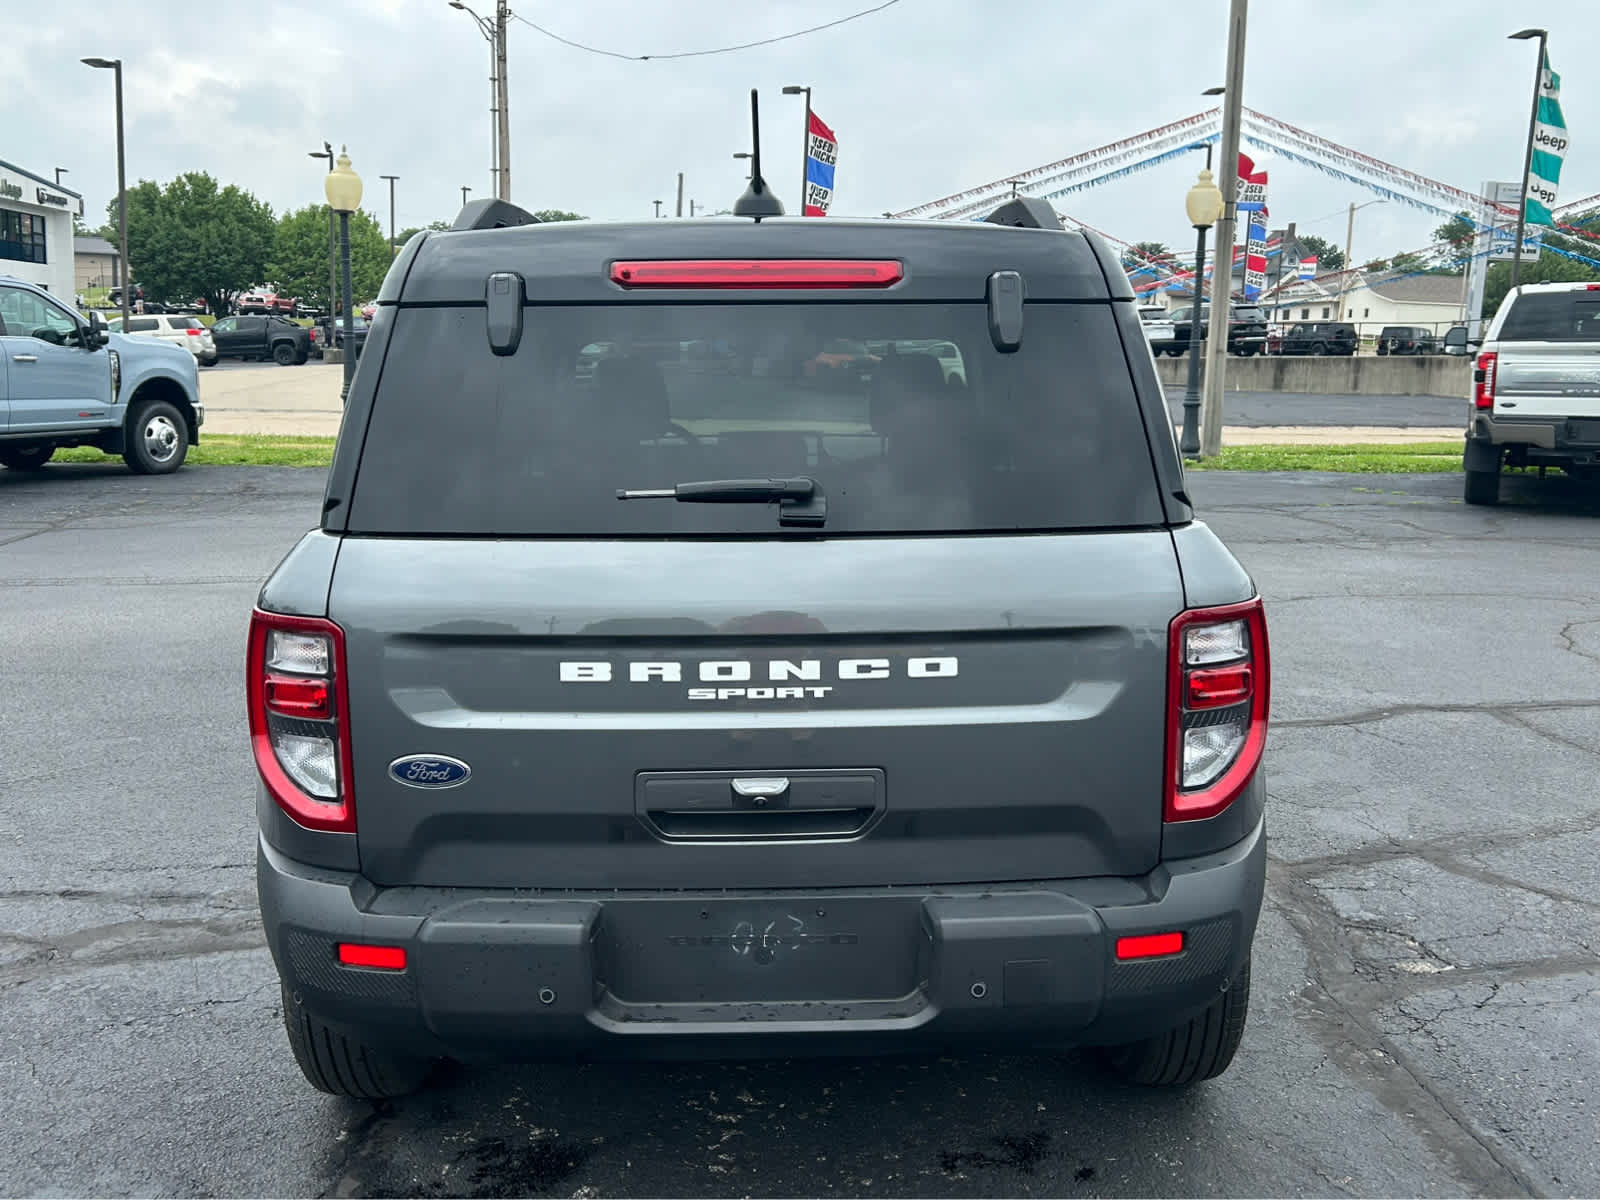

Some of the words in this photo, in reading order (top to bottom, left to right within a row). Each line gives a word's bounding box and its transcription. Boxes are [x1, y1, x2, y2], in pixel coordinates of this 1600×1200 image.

[812, 135, 834, 154] USED
[1535, 129, 1567, 151] Jeep
[810, 183, 829, 201] USED
[559, 656, 959, 682] BRONCO
[687, 686, 833, 700] SPORT
[406, 760, 451, 781] Ford
